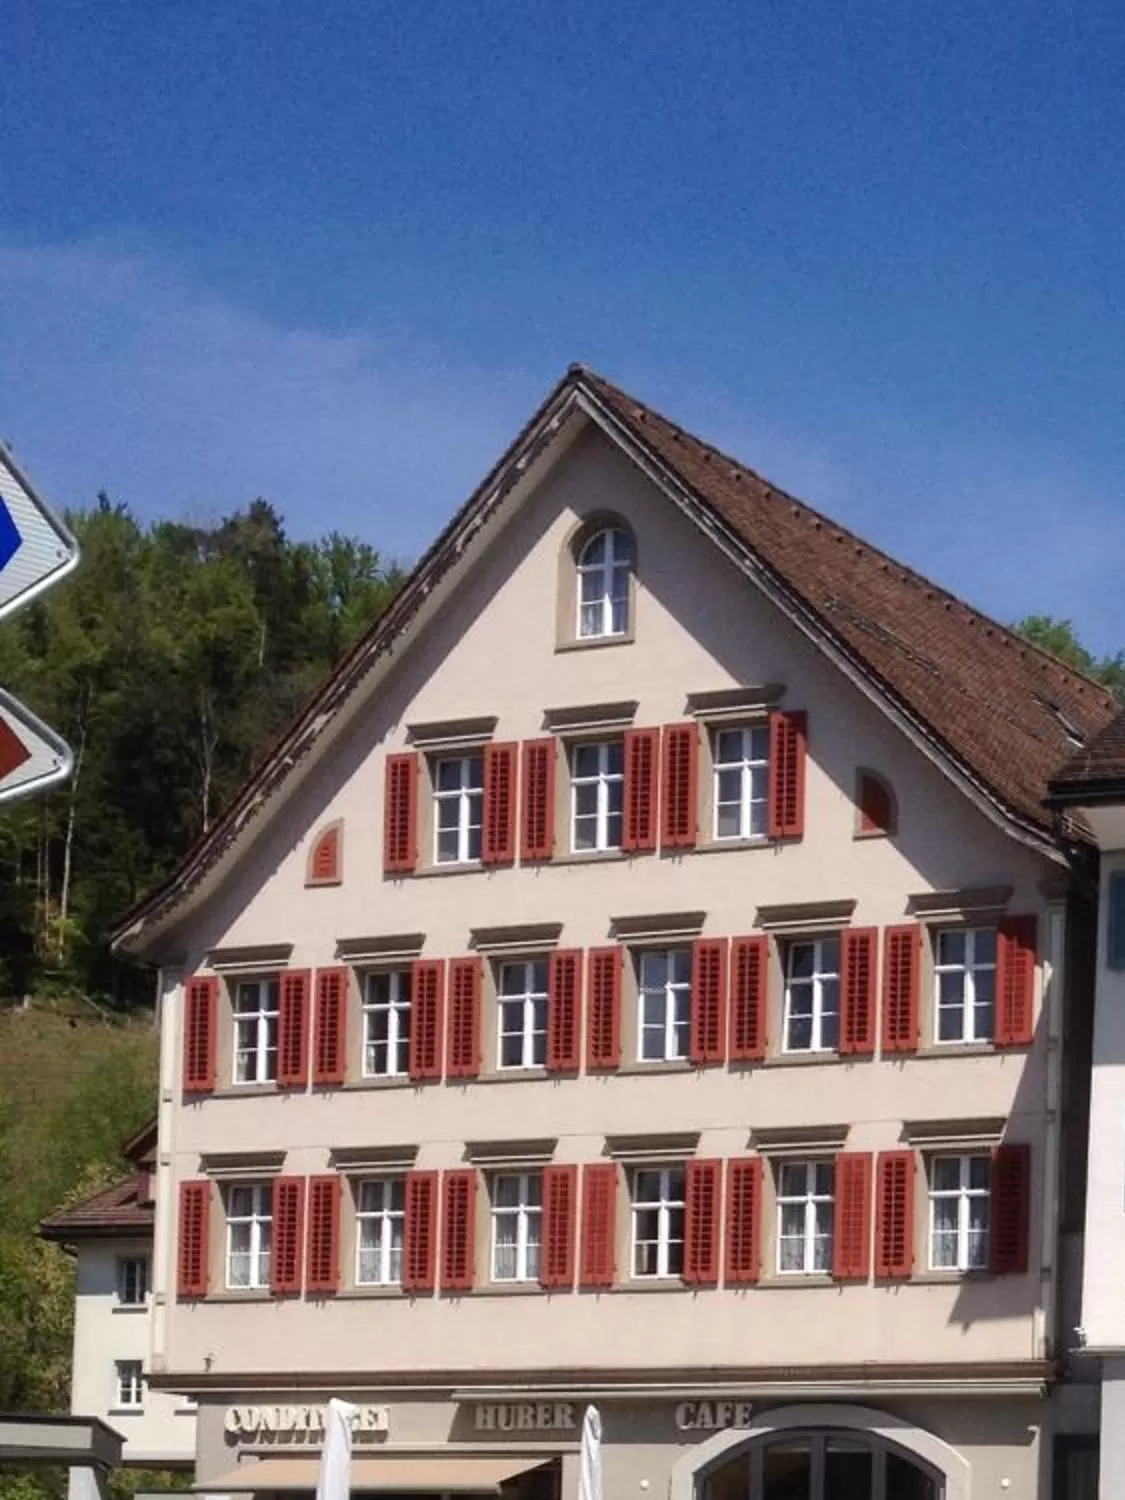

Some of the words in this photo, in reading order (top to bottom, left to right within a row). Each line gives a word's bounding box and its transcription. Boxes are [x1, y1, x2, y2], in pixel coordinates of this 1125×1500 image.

[223, 1405, 391, 1433] CONDITEI
[475, 1402, 577, 1430] HUBER
[675, 1402, 754, 1430] CAFE
